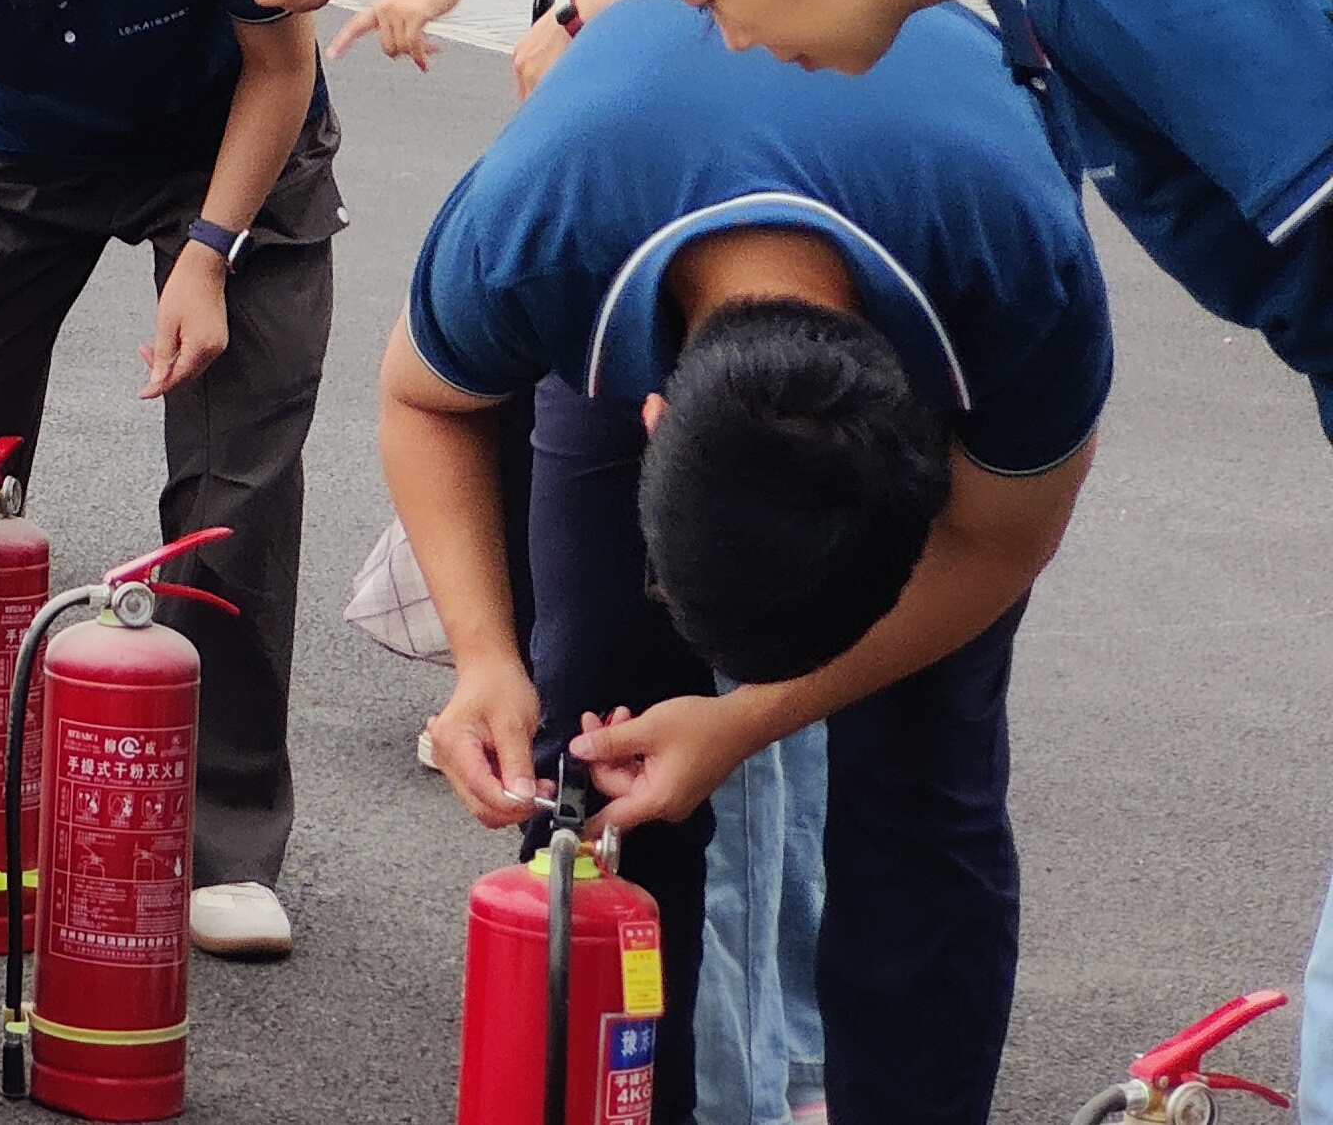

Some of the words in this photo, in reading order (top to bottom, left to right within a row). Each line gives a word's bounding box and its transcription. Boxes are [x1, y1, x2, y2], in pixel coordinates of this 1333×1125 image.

[67, 755, 185, 779] 手提式干粉灭火器
